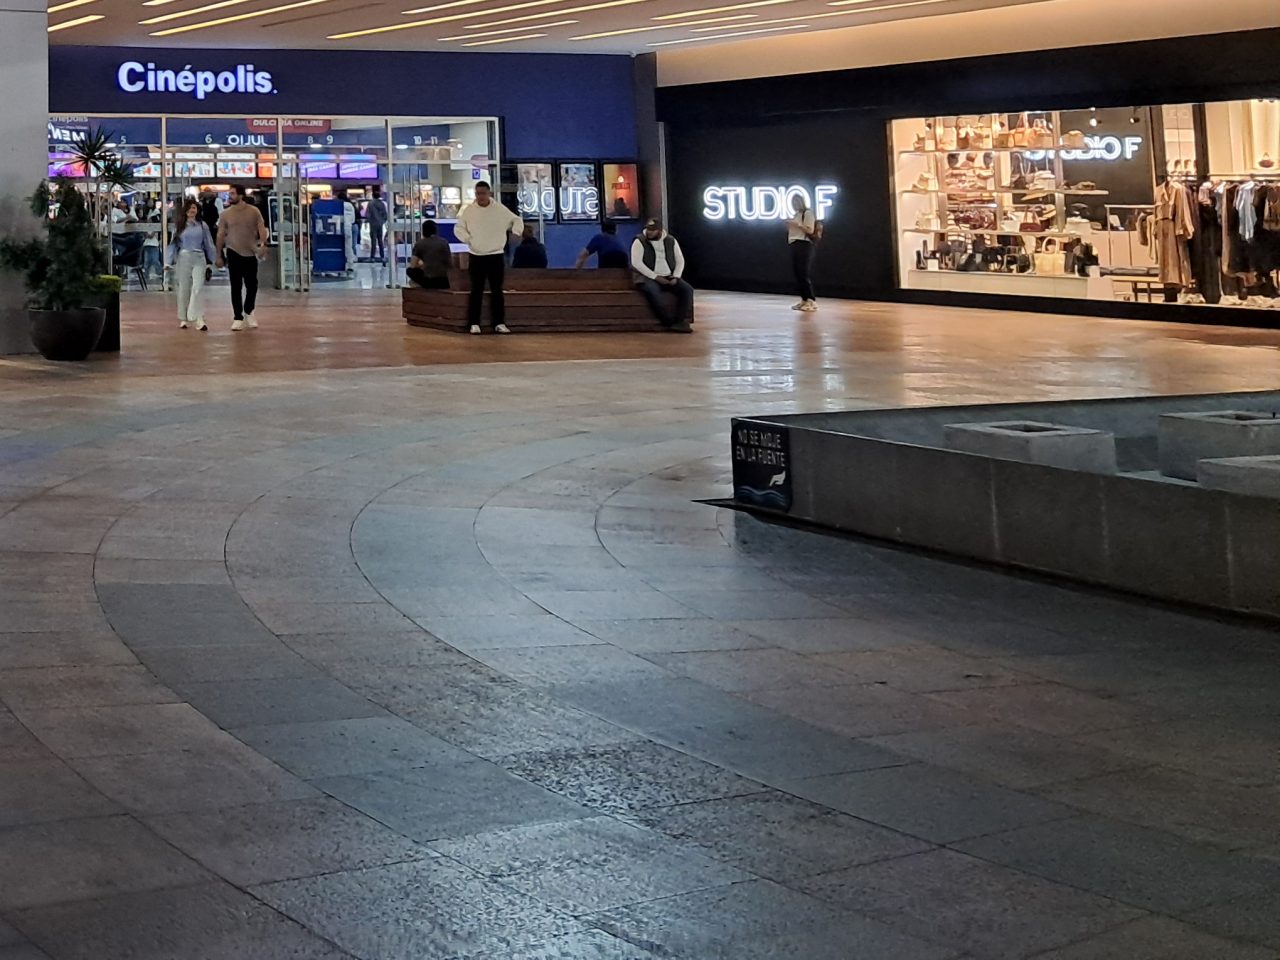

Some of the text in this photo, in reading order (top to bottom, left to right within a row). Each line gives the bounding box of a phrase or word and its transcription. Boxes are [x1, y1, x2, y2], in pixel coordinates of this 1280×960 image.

[120, 135, 127, 145] 5
[205, 134, 213, 144] 6
[307, 135, 314, 144] 8
[326, 135, 334, 144] 9
[413, 135, 422, 145] 10
[1124, 136, 1142, 159] F
[703, 185, 838, 220] STUDIO F
[738, 429, 782, 449] NO SE MOJE
[736, 445, 786, 468] EN LA FUENTE
